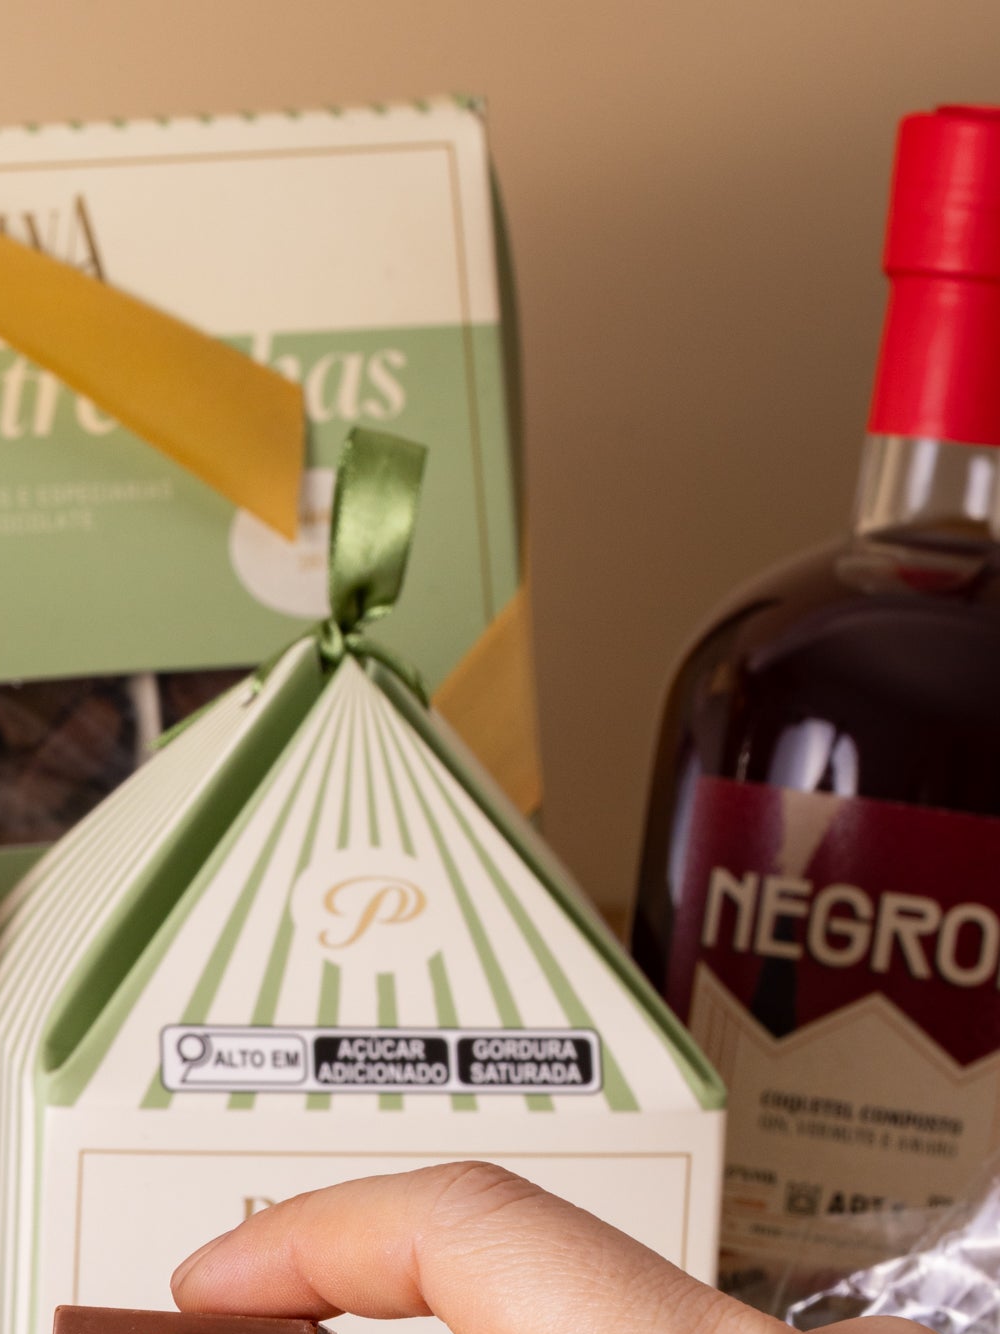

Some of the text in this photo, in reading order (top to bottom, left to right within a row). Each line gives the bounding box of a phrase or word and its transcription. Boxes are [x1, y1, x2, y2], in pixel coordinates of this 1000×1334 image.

[702, 865, 1000, 990] NEGRO
[214, 1050, 299, 1069] ALTO EM
[336, 1036, 426, 1064] AÇÚCAR
[472, 1039, 578, 1061] GORDURA
[318, 1063, 448, 1085] ADICIONADO
[469, 1062, 582, 1085] SATURADA
